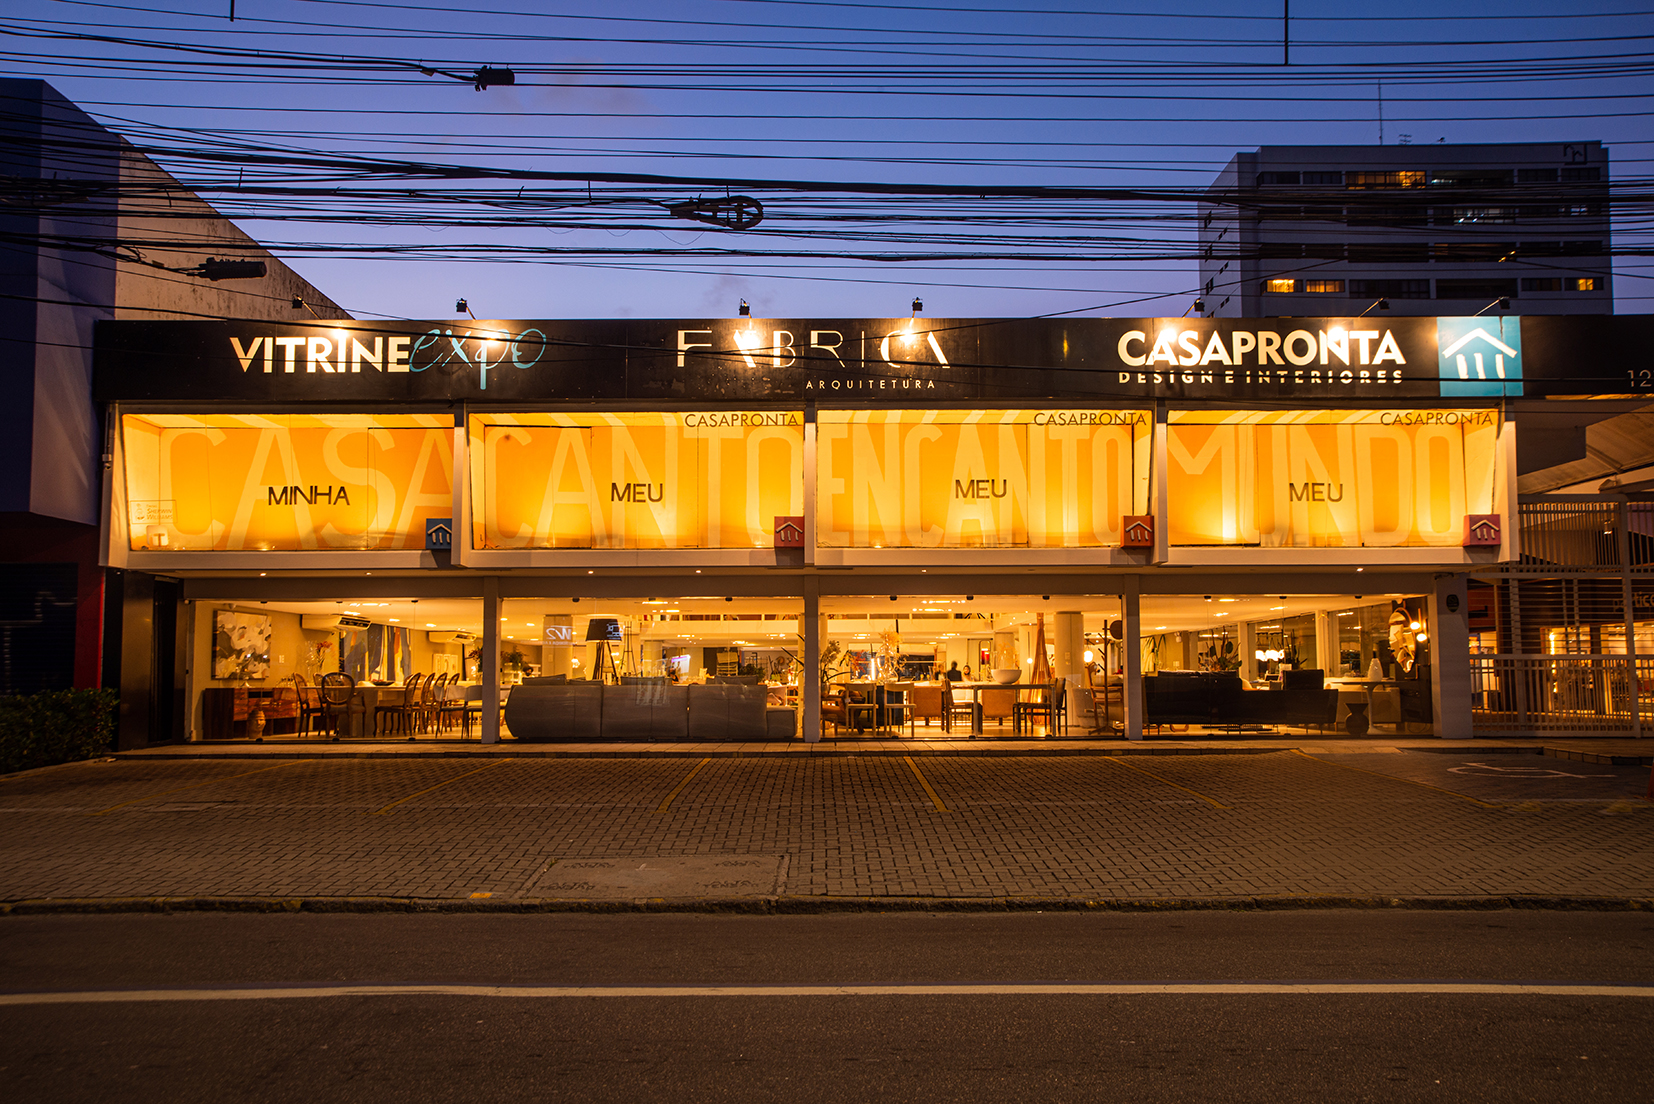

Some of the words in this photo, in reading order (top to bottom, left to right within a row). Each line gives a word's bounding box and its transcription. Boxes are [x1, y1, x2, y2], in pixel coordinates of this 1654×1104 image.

[230, 335, 411, 374] VITRINE
[1117, 328, 1408, 367] CASAPRONTA
[805, 379, 936, 391] ARQUITETURA
[1118, 369, 1214, 384] DESIGN
[1224, 370, 1236, 384] E
[1246, 369, 1404, 384] INTERIORES
[1626, 368, 1654, 388] 12
[684, 413, 799, 428] CASAPRONTA
[1033, 411, 1148, 427] CASAPRONTA
[1380, 411, 1494, 427] CASAPRONTA
[158, 426, 455, 549] CASA
[268, 485, 351, 506] MINHA
[484, 425, 804, 548] CANTO
[610, 482, 664, 503] MEU
[816, 423, 1133, 548] ENCANTO
[955, 478, 1008, 500] MEU
[1288, 482, 1344, 503] MEU
